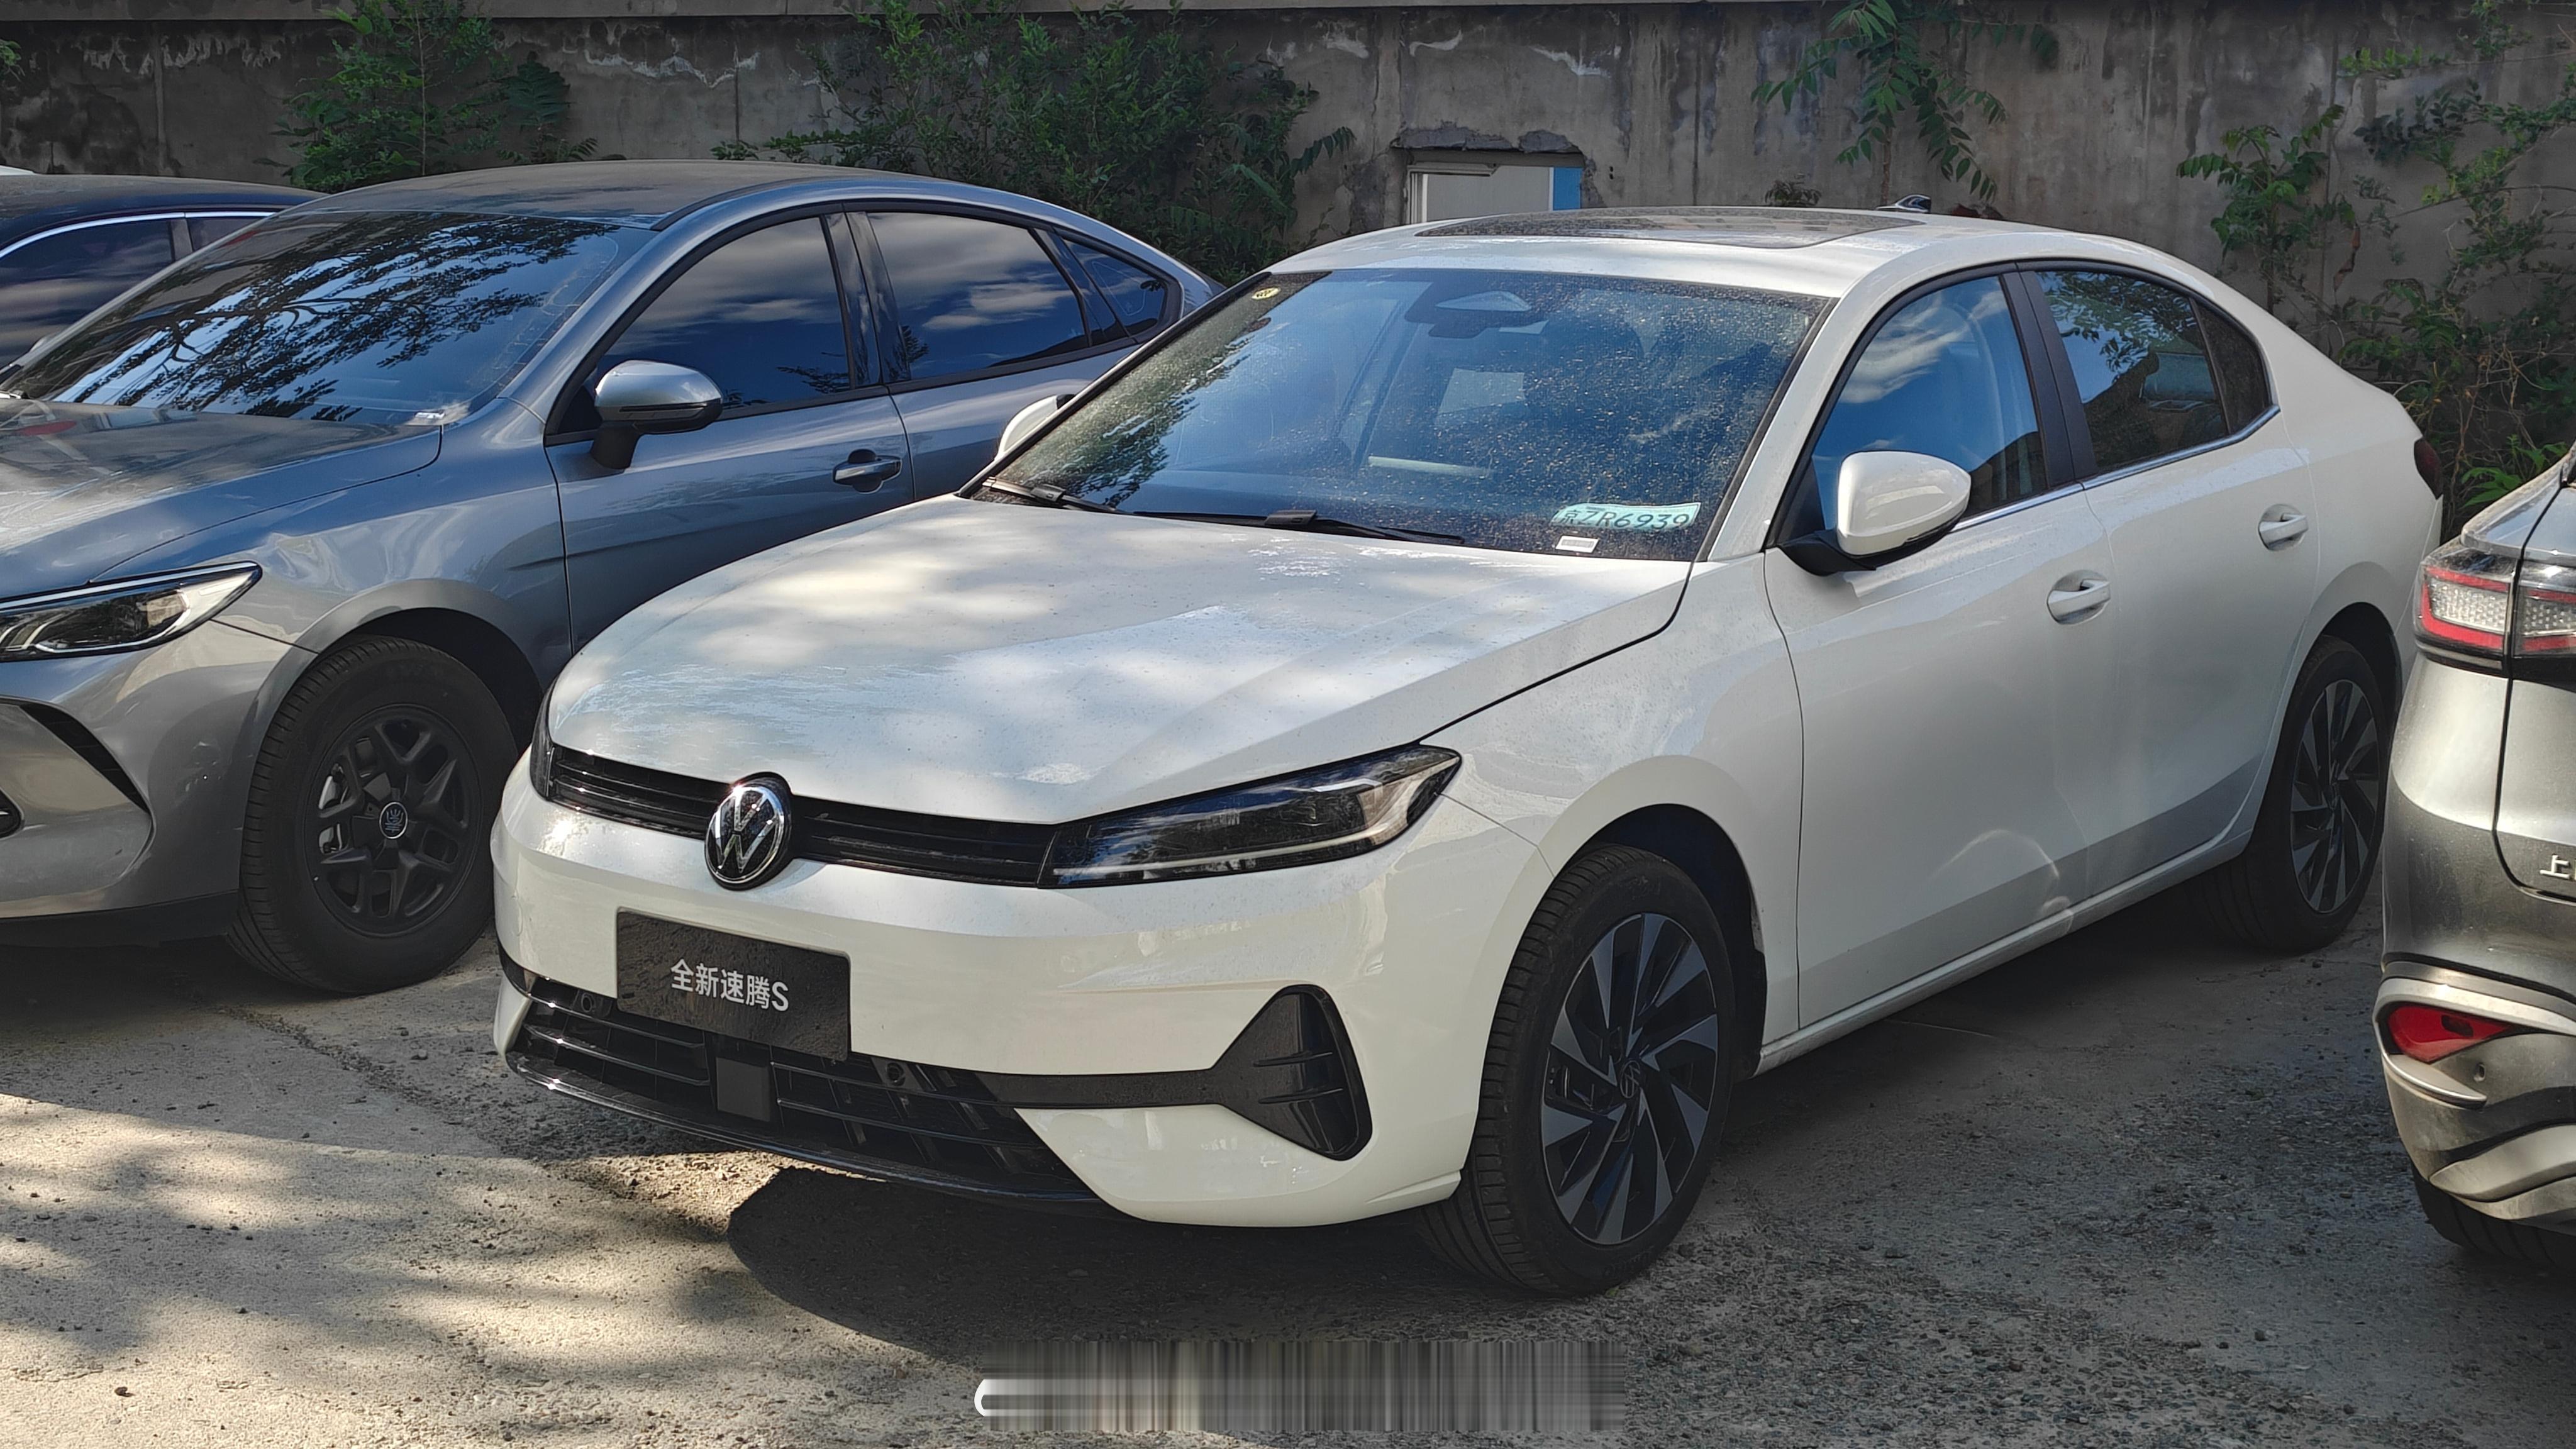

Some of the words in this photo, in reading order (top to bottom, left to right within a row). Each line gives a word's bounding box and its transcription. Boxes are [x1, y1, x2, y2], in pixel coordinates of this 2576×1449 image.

[2540, 855, 2576, 881] 上
[670, 958, 789, 1012] 全新速腾S
